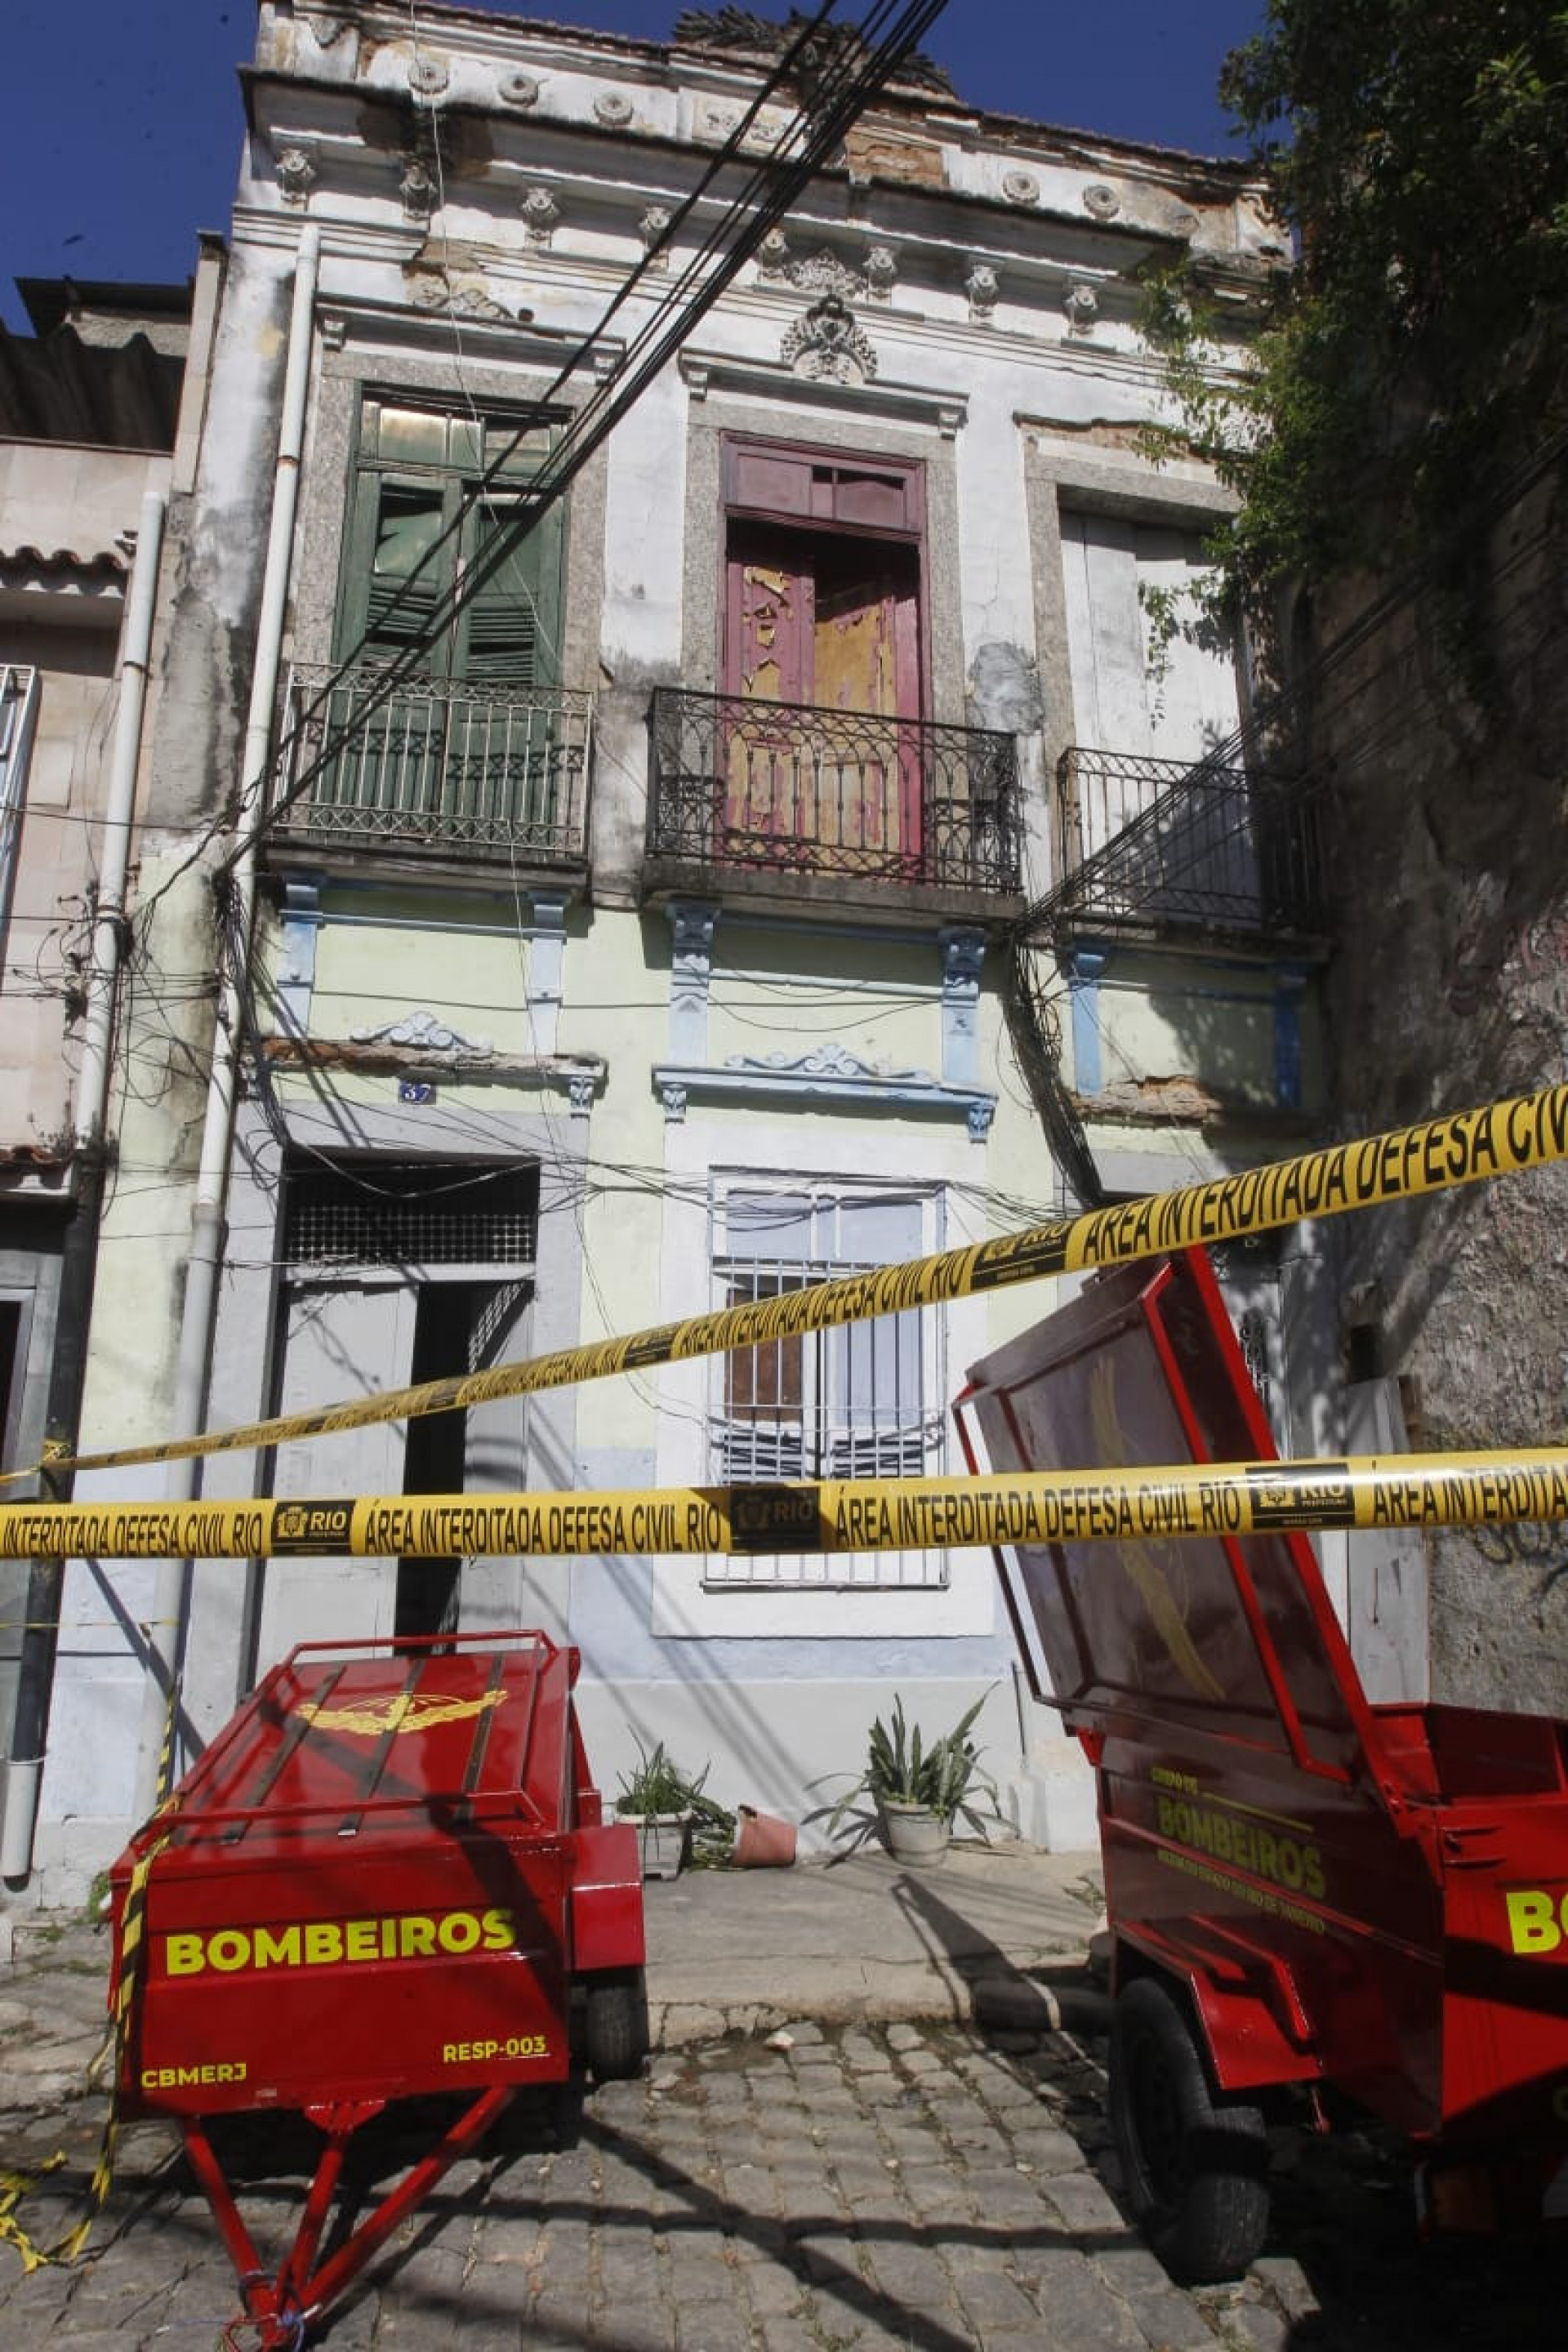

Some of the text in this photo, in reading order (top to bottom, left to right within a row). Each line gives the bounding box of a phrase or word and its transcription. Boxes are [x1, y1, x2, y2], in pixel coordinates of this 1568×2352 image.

[1159, 1147, 1348, 1246] INTERDITADA
[1356, 1105, 1498, 1200] DEFESA
[3, 1512, 263, 1556] INTERDITADA DEFESA CIVIL RIO
[310, 1510, 346, 1530] RIO
[365, 1499, 721, 1553] ÁREA INTERDITADA DEFESA CIVIL RIO
[835, 1480, 1241, 1548] ÁREA INTERDITADA DEFESA CIVIL RIO
[1158, 1795, 1326, 1899] BOMBEIROS
[167, 1909, 516, 1976] BOMBEIROS
[1506, 1890, 1568, 1953] B
[141, 2062, 247, 2089] CBMERJ
[443, 2036, 546, 2063] RESP-003
